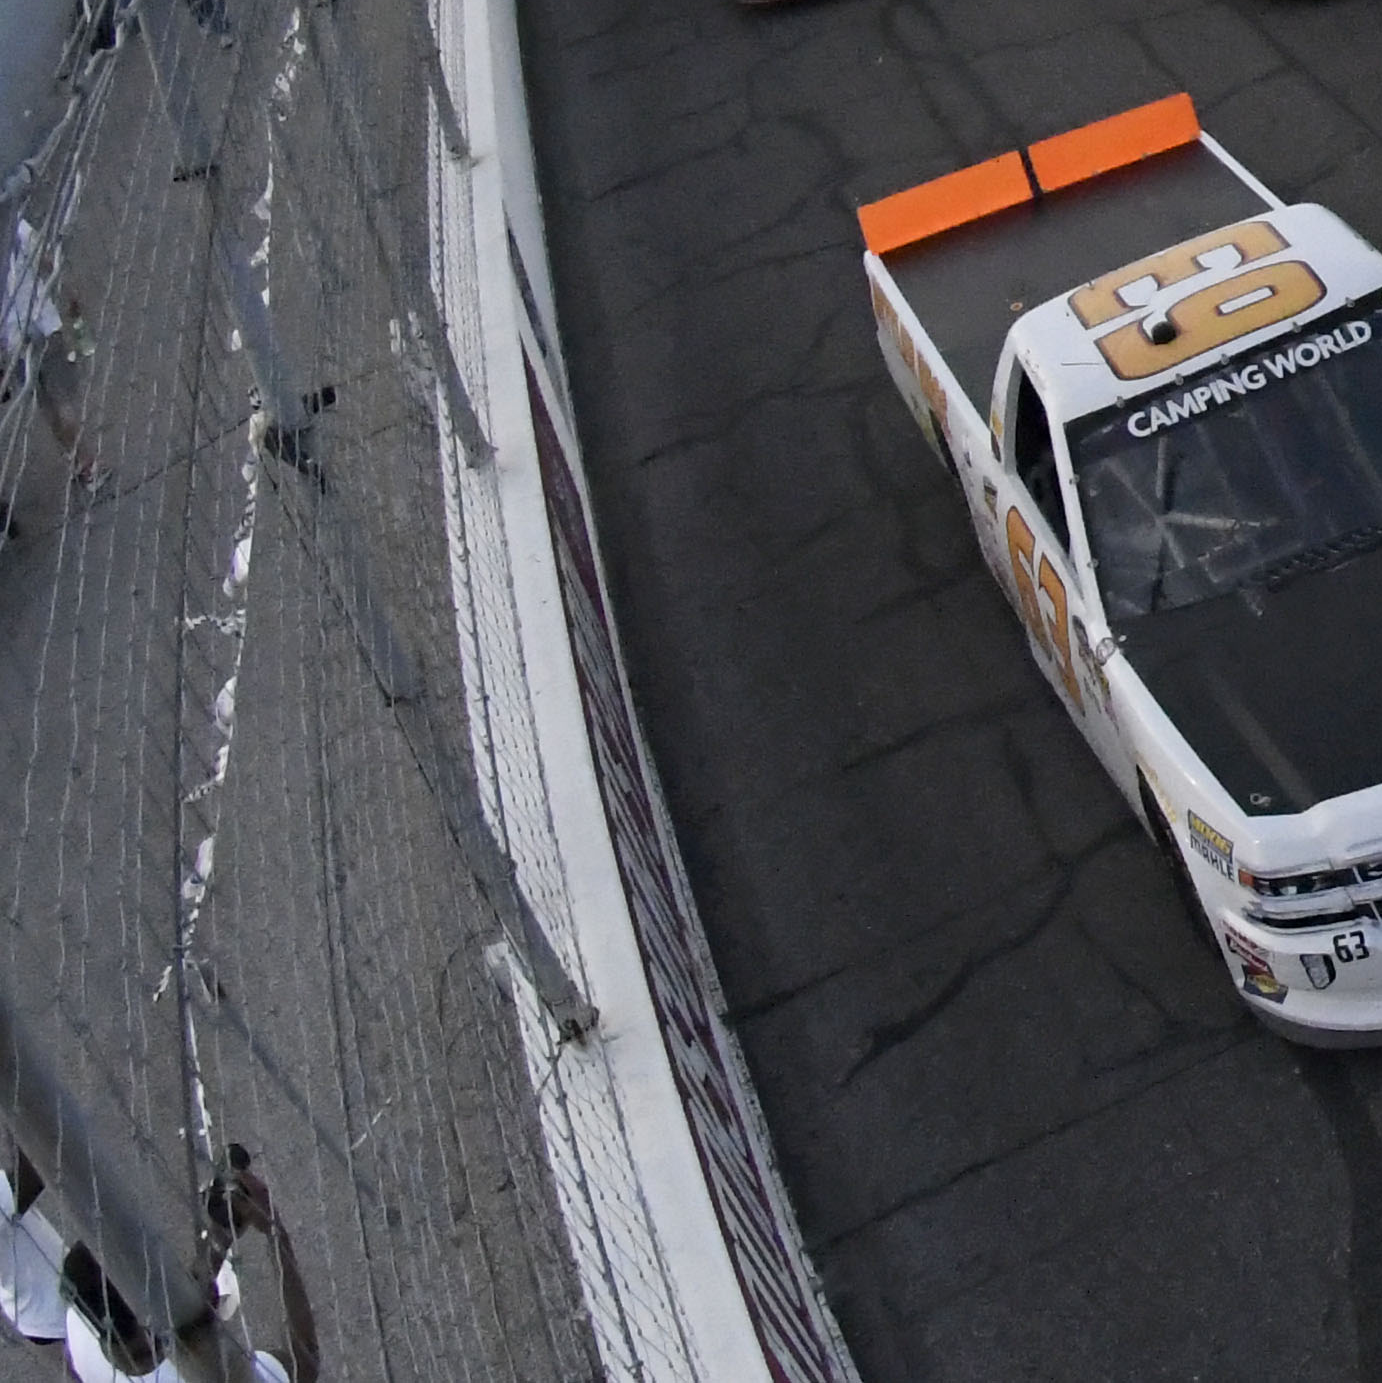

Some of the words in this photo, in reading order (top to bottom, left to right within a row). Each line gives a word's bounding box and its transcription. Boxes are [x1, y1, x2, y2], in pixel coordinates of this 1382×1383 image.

[1068, 220, 1328, 381] 63
[1127, 363, 1267, 438] CAMPING
[1263, 320, 1372, 380] WORLD
[1190, 834, 1235, 882] MAHLE
[1333, 930, 1369, 963] 63
